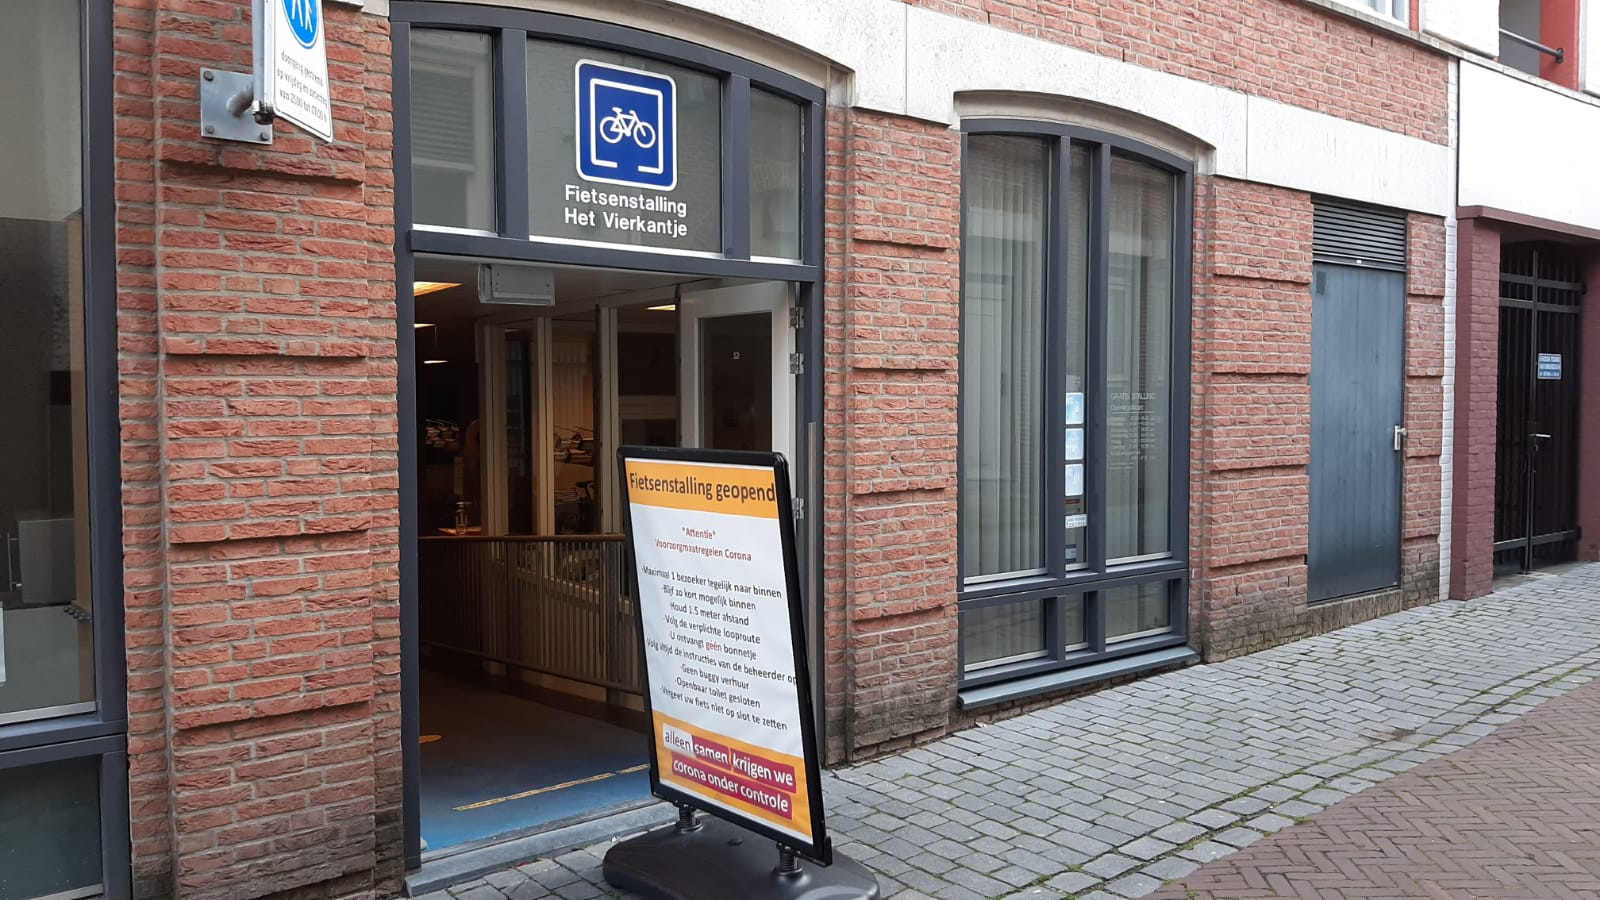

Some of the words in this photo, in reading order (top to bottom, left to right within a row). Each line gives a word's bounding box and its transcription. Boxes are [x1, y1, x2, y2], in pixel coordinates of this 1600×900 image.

[565, 184, 687, 218] Fietsenstalling
[564, 207, 596, 226] Het
[603, 211, 688, 238] Vierkantje
[629, 472, 713, 501] Fietsenstalling
[716, 483, 776, 504] geopend
[724, 548, 752, 562] Corona
[671, 571, 676, 581] 1
[677, 572, 707, 586] bezoeker
[707, 578, 732, 593] tegelijk
[734, 584, 752, 594] naar
[753, 584, 782, 599] binnen
[684, 588, 697, 600] kort
[698, 592, 728, 608] mogelijk
[728, 597, 757, 611] binnen
[699, 609, 721, 621] meter
[722, 612, 749, 626] afstand
[678, 619, 688, 629] de
[689, 622, 722, 638] verplichte
[723, 627, 761, 645] looproute
[676, 634, 705, 649] ontvangt
[723, 643, 757, 661] bonnetje
[674, 646, 683, 657] de
[683, 648, 717, 666] instructies
[717, 659, 731, 670] van
[732, 662, 743, 673] de
[743, 664, 786, 682] beheerder
[699, 668, 720, 684] buggy
[720, 674, 750, 690] verhuur
[708, 686, 728, 700] toilet
[728, 693, 761, 709] gesloten
[684, 695, 694, 704] uw
[695, 696, 710, 710] fiets
[710, 702, 725, 715] niet
[725, 707, 736, 719] op
[736, 710, 751, 722] slot
[751, 713, 761, 724] te
[761, 717, 788, 731] zetten
[664, 729, 692, 752] alleen
[693, 742, 730, 765] samen
[732, 752, 773, 781] krijgen
[772, 769, 794, 787] we
[673, 760, 707, 781] corona
[707, 774, 739, 793] onder
[739, 784, 790, 814] controle
